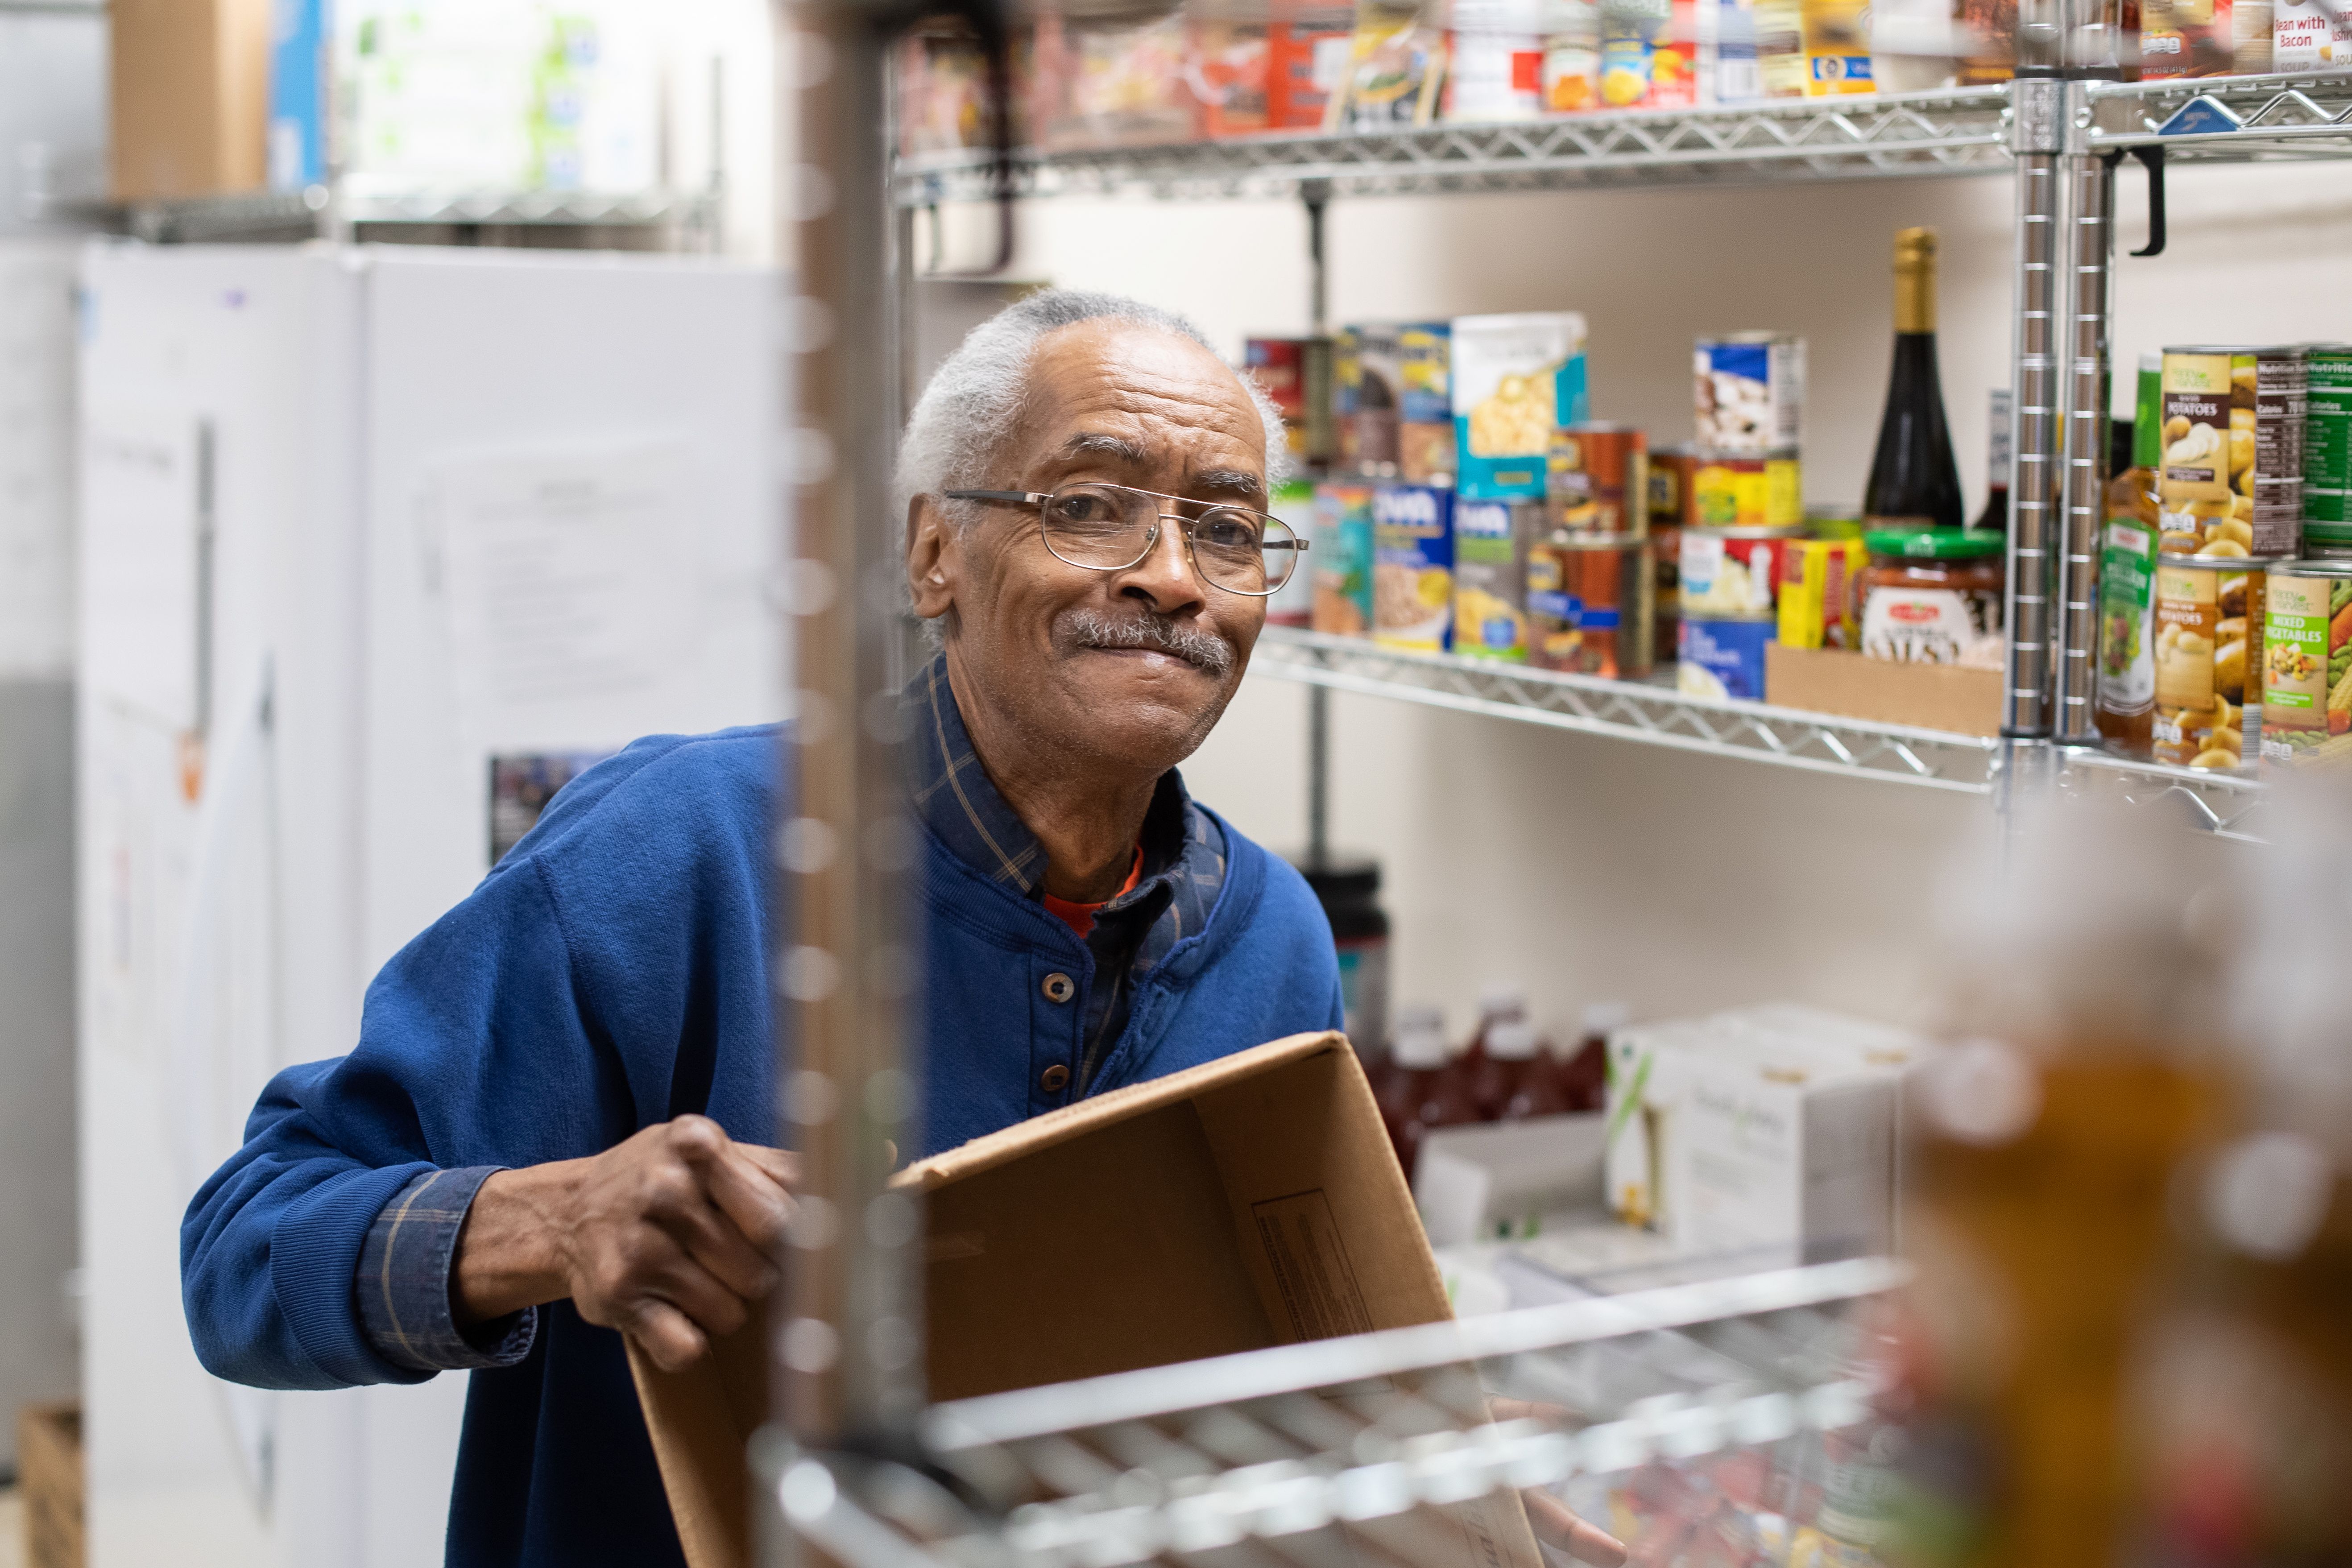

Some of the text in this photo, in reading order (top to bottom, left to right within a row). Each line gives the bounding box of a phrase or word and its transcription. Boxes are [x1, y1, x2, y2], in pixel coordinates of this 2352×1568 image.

[2297, 16, 2325, 29] with
[2281, 35, 2311, 47] Bacon
[2335, 54, 2352, 66] SOU
[2167, 402, 2218, 416] POTATOES
[2273, 616, 2305, 629] MIXED
